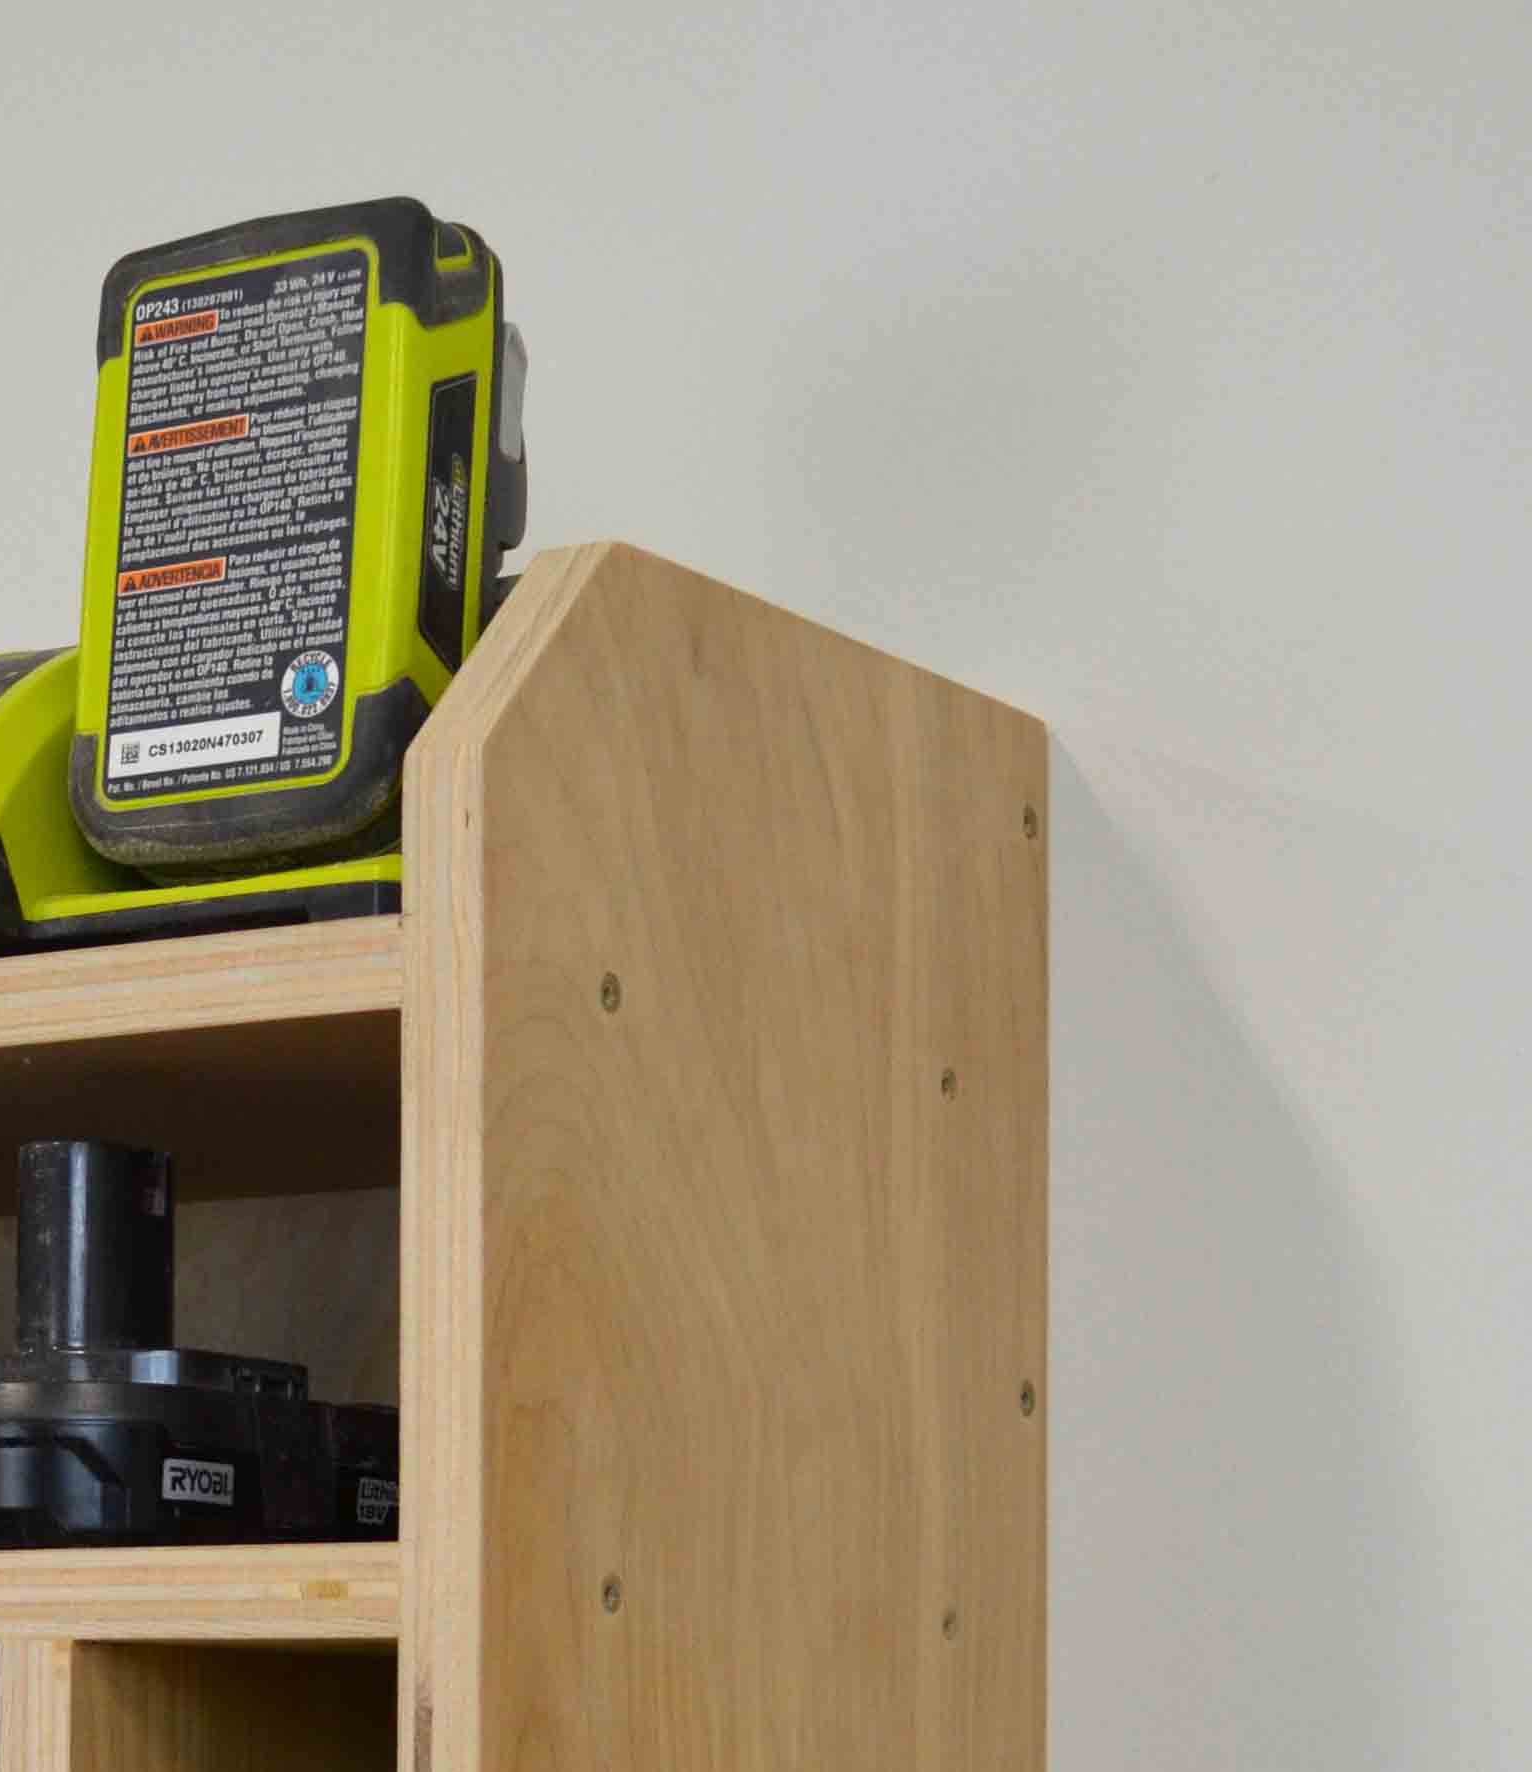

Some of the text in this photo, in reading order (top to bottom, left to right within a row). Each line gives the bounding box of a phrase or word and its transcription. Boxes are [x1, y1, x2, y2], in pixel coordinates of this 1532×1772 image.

[274, 279, 287, 294] 33
[312, 271, 324, 285] 24
[135, 298, 179, 321] OP243
[220, 287, 338, 319] To reduce the risk of injury
[155, 314, 214, 340] WARNING
[156, 346, 165, 358] of
[191, 337, 208, 351] and
[244, 328, 256, 340] Do
[259, 325, 275, 337] not
[240, 343, 249, 354] or
[252, 338, 277, 352] Short
[267, 341, 332, 363] Use only with
[132, 385, 166, 401] charger
[170, 379, 195, 394] listed
[199, 377, 207, 388] in
[261, 359, 297, 376] manual
[300, 357, 310, 368] or
[131, 397, 168, 414] Remove
[171, 391, 203, 407] battery
[207, 386, 227, 400] from
[229, 383, 247, 396] tool
[249, 378, 274, 393] when
[193, 404, 202, 415] or
[205, 397, 240, 413] making
[147, 416, 246, 449] AVERTISSEMENT
[138, 457, 229, 482] de Ne pas
[165, 479, 176, 491] de
[206, 484, 220, 497] les
[224, 474, 281, 494] instructions
[143, 535, 154, 547] de
[430, 476, 451, 581] 24V
[192, 539, 209, 552] des
[229, 538, 339, 565] Para reducir el riesgo de
[141, 561, 220, 589] ADVERTENCIA
[270, 561, 279, 572] el
[318, 551, 341, 564] debe
[138, 595, 146, 606] el
[149, 589, 183, 605] manual
[186, 587, 200, 599] del
[284, 571, 296, 583] de
[125, 610, 136, 622] de
[139, 603, 178, 619] lesiones
[181, 600, 197, 613] por
[114, 642, 180, 662] instrucciones
[184, 639, 199, 651] del
[296, 622, 305, 634] la
[308, 616, 342, 632] unidad
[116, 621, 151, 636] caliente
[127, 631, 165, 647] conecte
[187, 619, 240, 638] terminales
[243, 617, 255, 629] en
[291, 608, 314, 622] Siga
[317, 605, 332, 618] las
[163, 655, 178, 667] con
[180, 654, 189, 665] el
[236, 640, 276, 656] indicado
[279, 638, 291, 650] en
[294, 636, 302, 647] el
[112, 677, 127, 689] del
[130, 670, 172, 687] operador
[183, 666, 194, 678] en
[233, 656, 261, 670] Retire
[264, 654, 272, 666] la
[145, 685, 156, 697] de
[226, 669, 259, 684] cuando
[179, 702, 212, 718] realice
[148, 729, 263, 757] CS13020N470307
[169, 1467, 230, 1496] RYOBI
